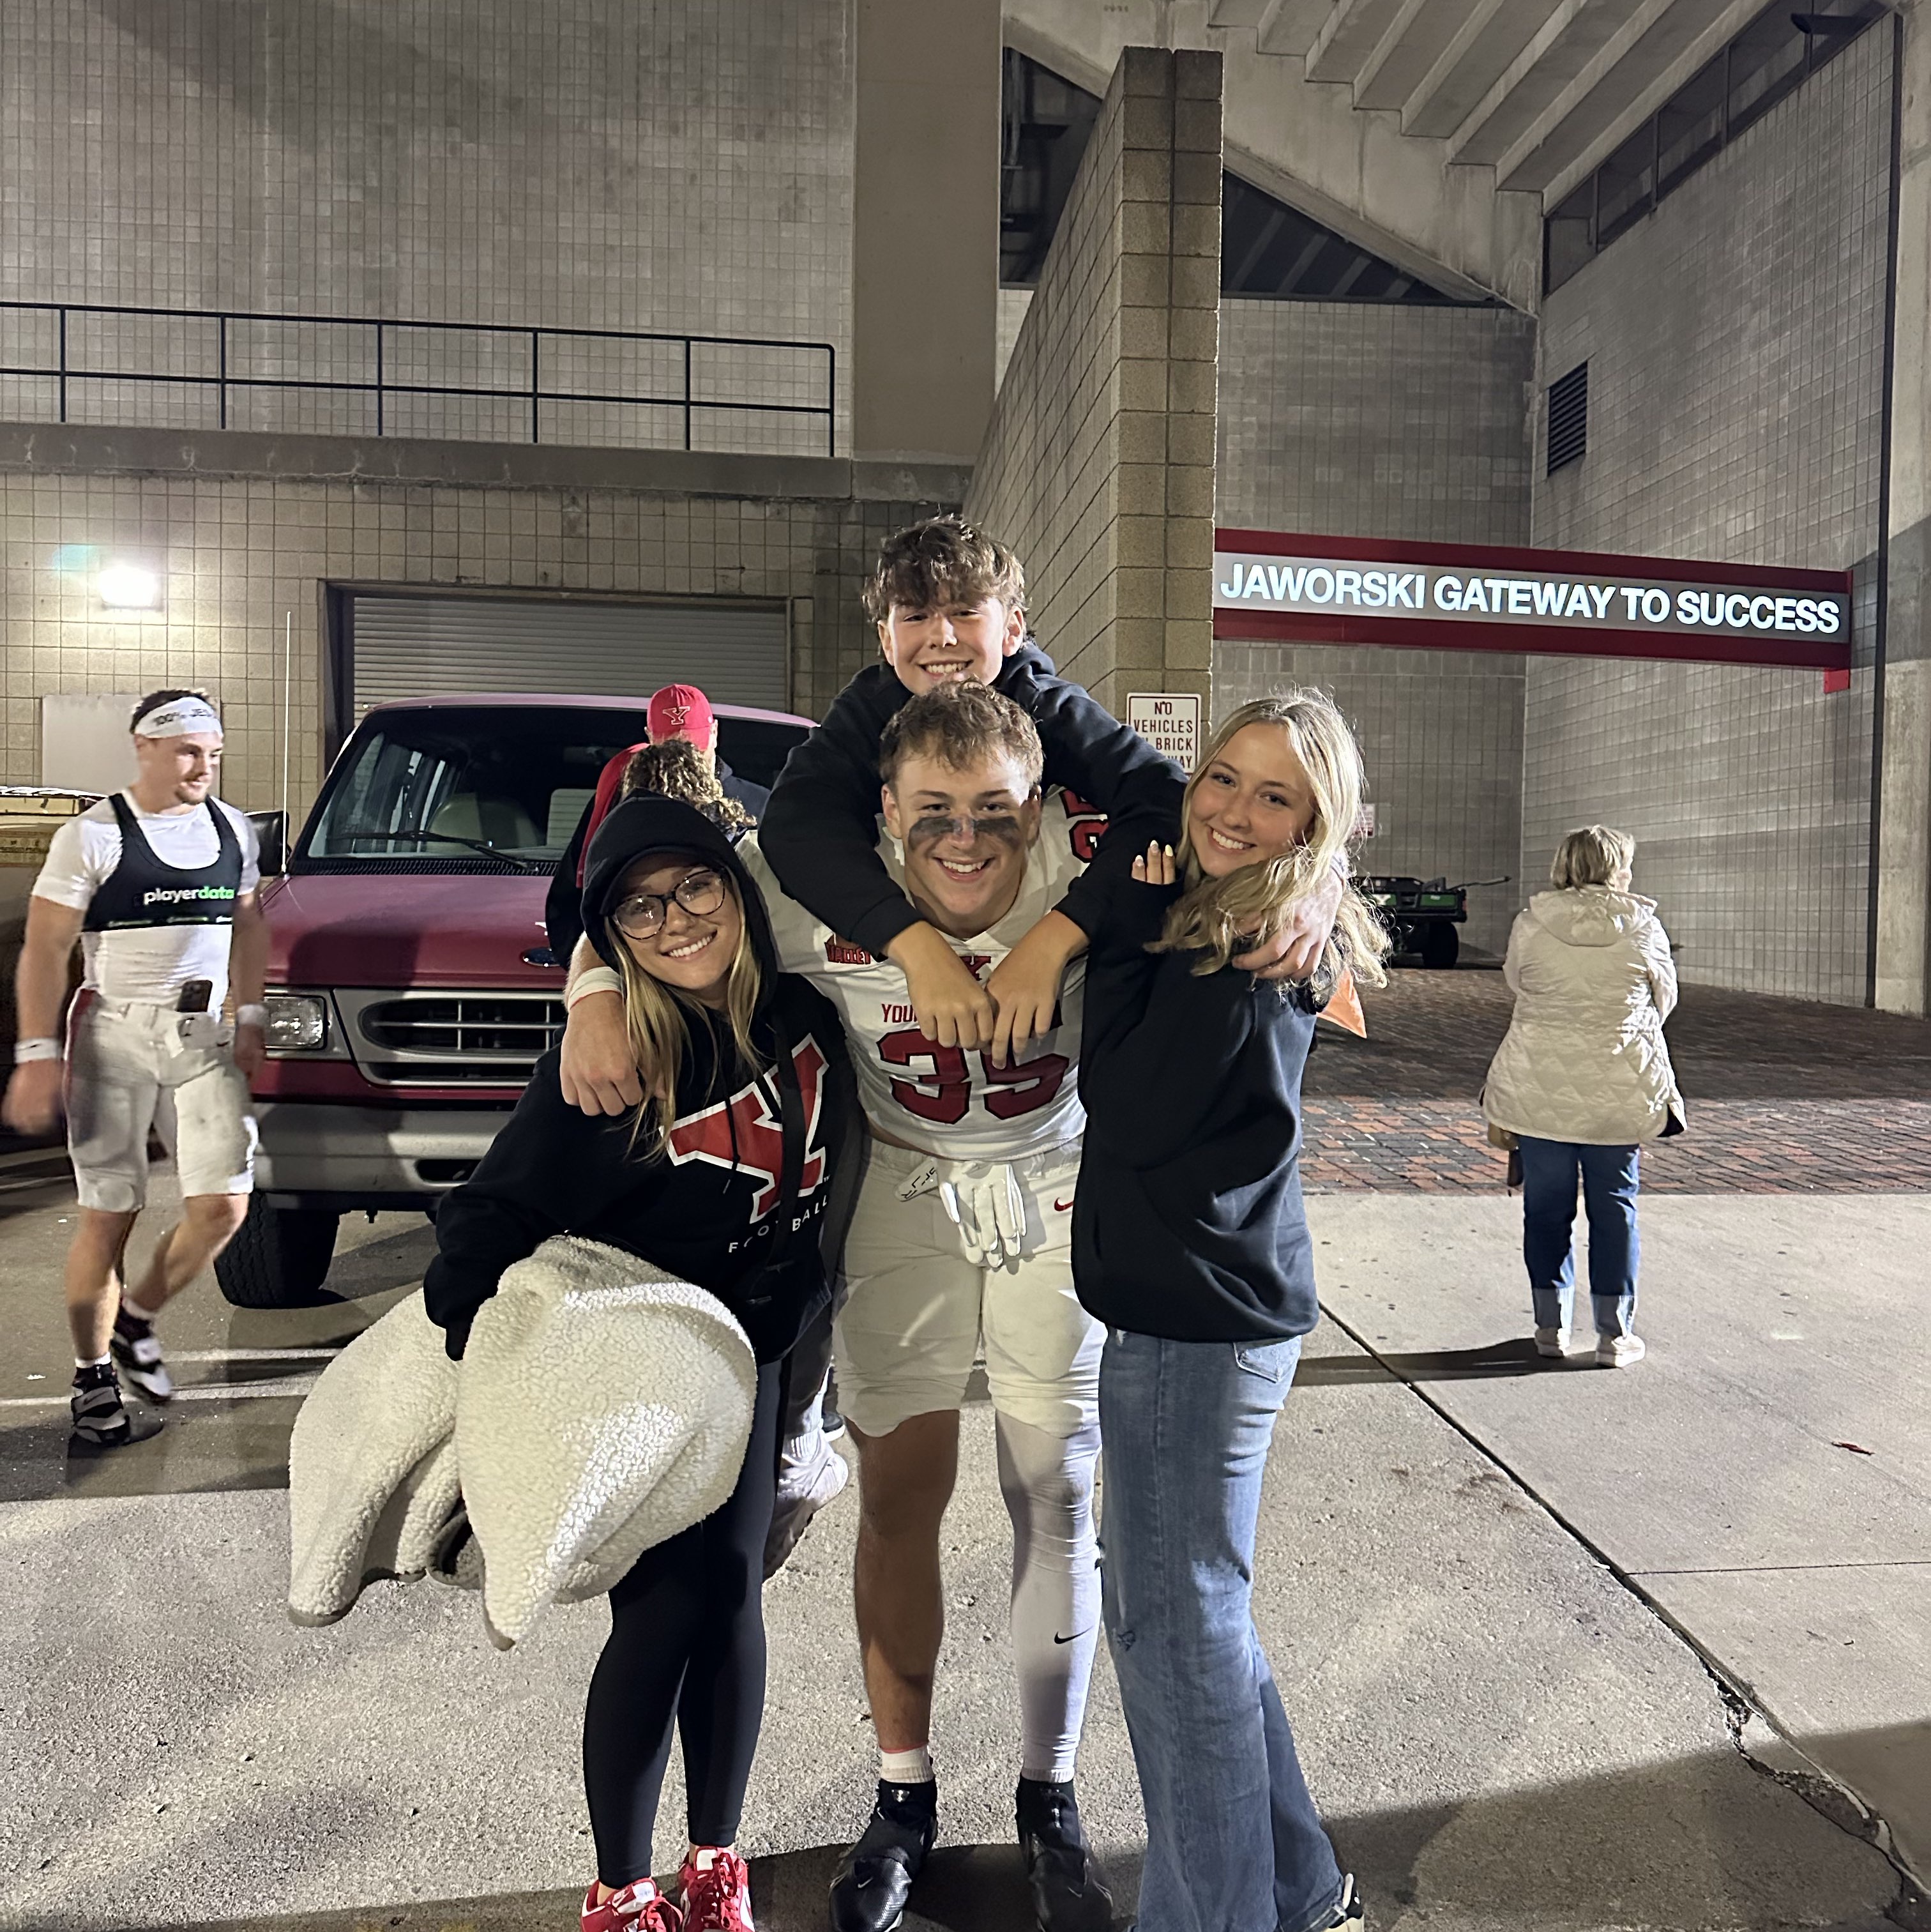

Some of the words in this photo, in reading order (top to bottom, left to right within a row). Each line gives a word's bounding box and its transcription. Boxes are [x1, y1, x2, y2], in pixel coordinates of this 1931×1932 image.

[1220, 563, 1425, 609] JAWORSKI
[1433, 575, 1616, 620] GATEWAY
[1619, 586, 1671, 623] TO
[1676, 589, 1840, 634] SUCCESS
[662, 706, 690, 725] Y
[1155, 702, 1172, 715] NO
[1133, 719, 1193, 733] VEHICLES
[1156, 737, 1193, 750] BRICK
[143, 886, 235, 906] playerdata
[881, 1003, 918, 1023] YOU
[877, 1000, 1070, 1125] 35
[658, 1032, 829, 1224] Y
[728, 1195, 828, 1253] FOBALL
